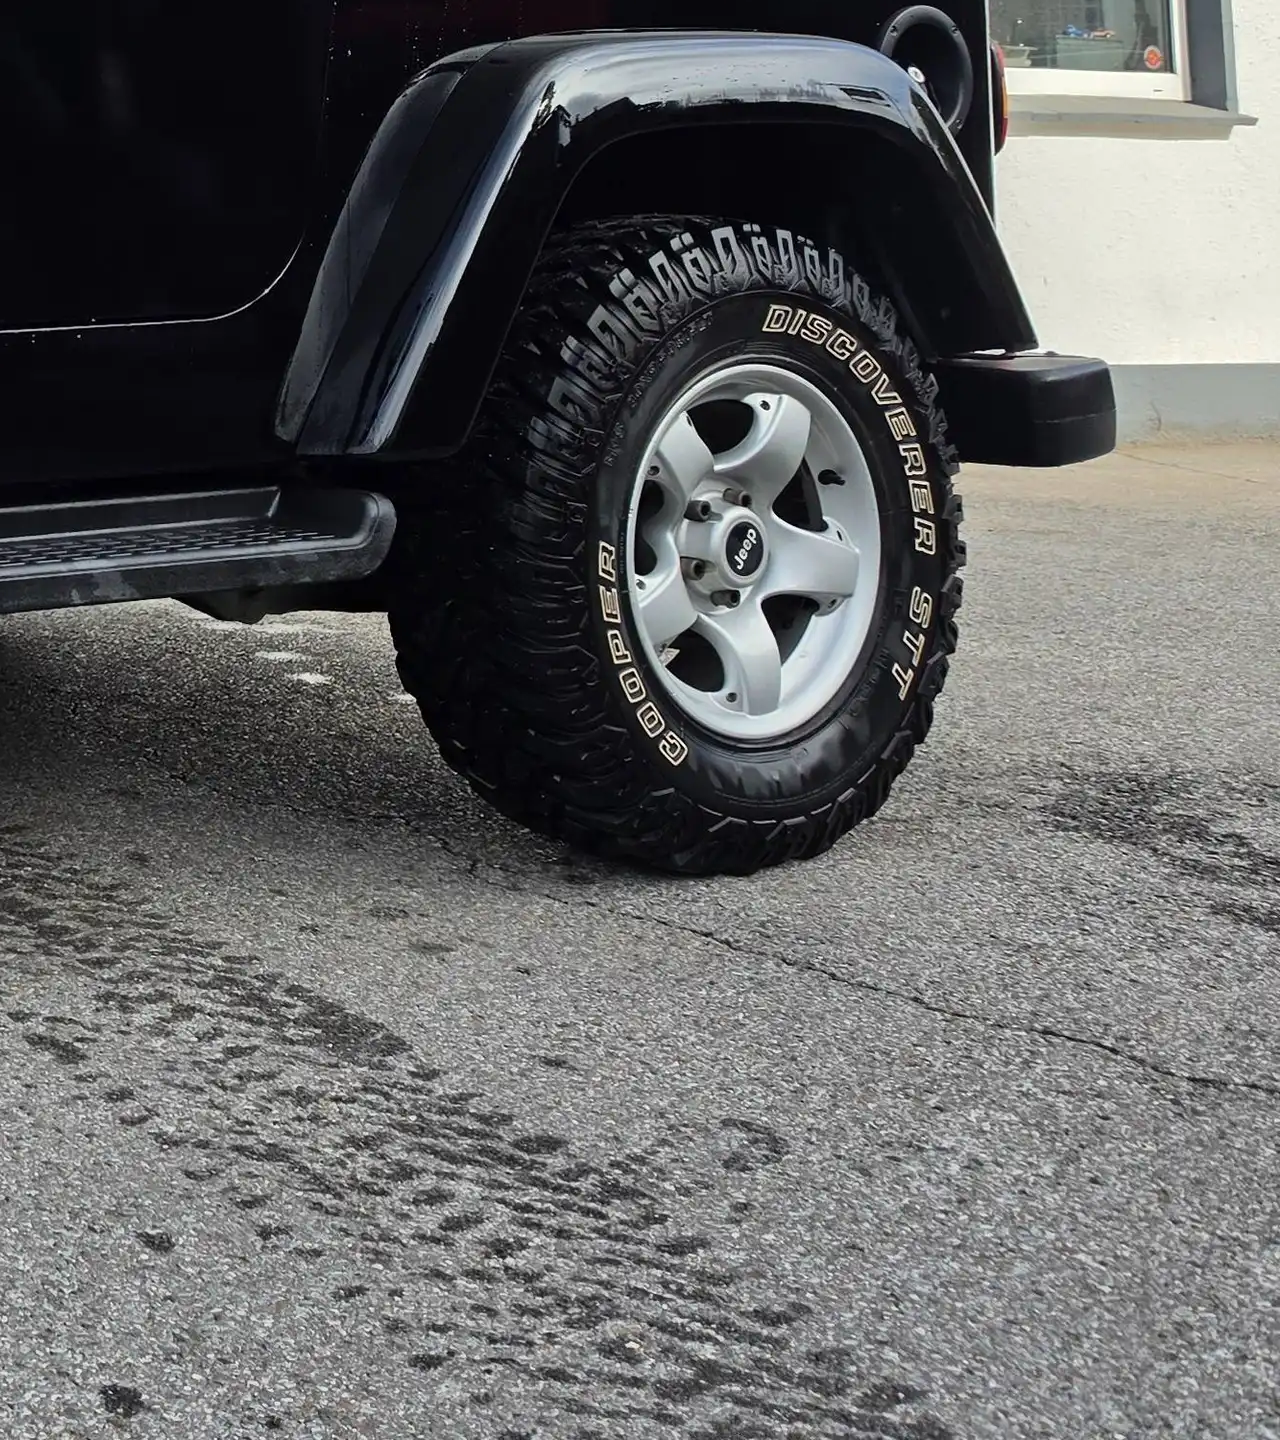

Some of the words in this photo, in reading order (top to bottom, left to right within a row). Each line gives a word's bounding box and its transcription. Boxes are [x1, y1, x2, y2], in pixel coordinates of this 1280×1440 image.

[734, 528, 757, 570] Jeep
[761, 303, 936, 556] DISCOVERER
[891, 584, 934, 701] STT
[598, 540, 689, 766] COOPER
